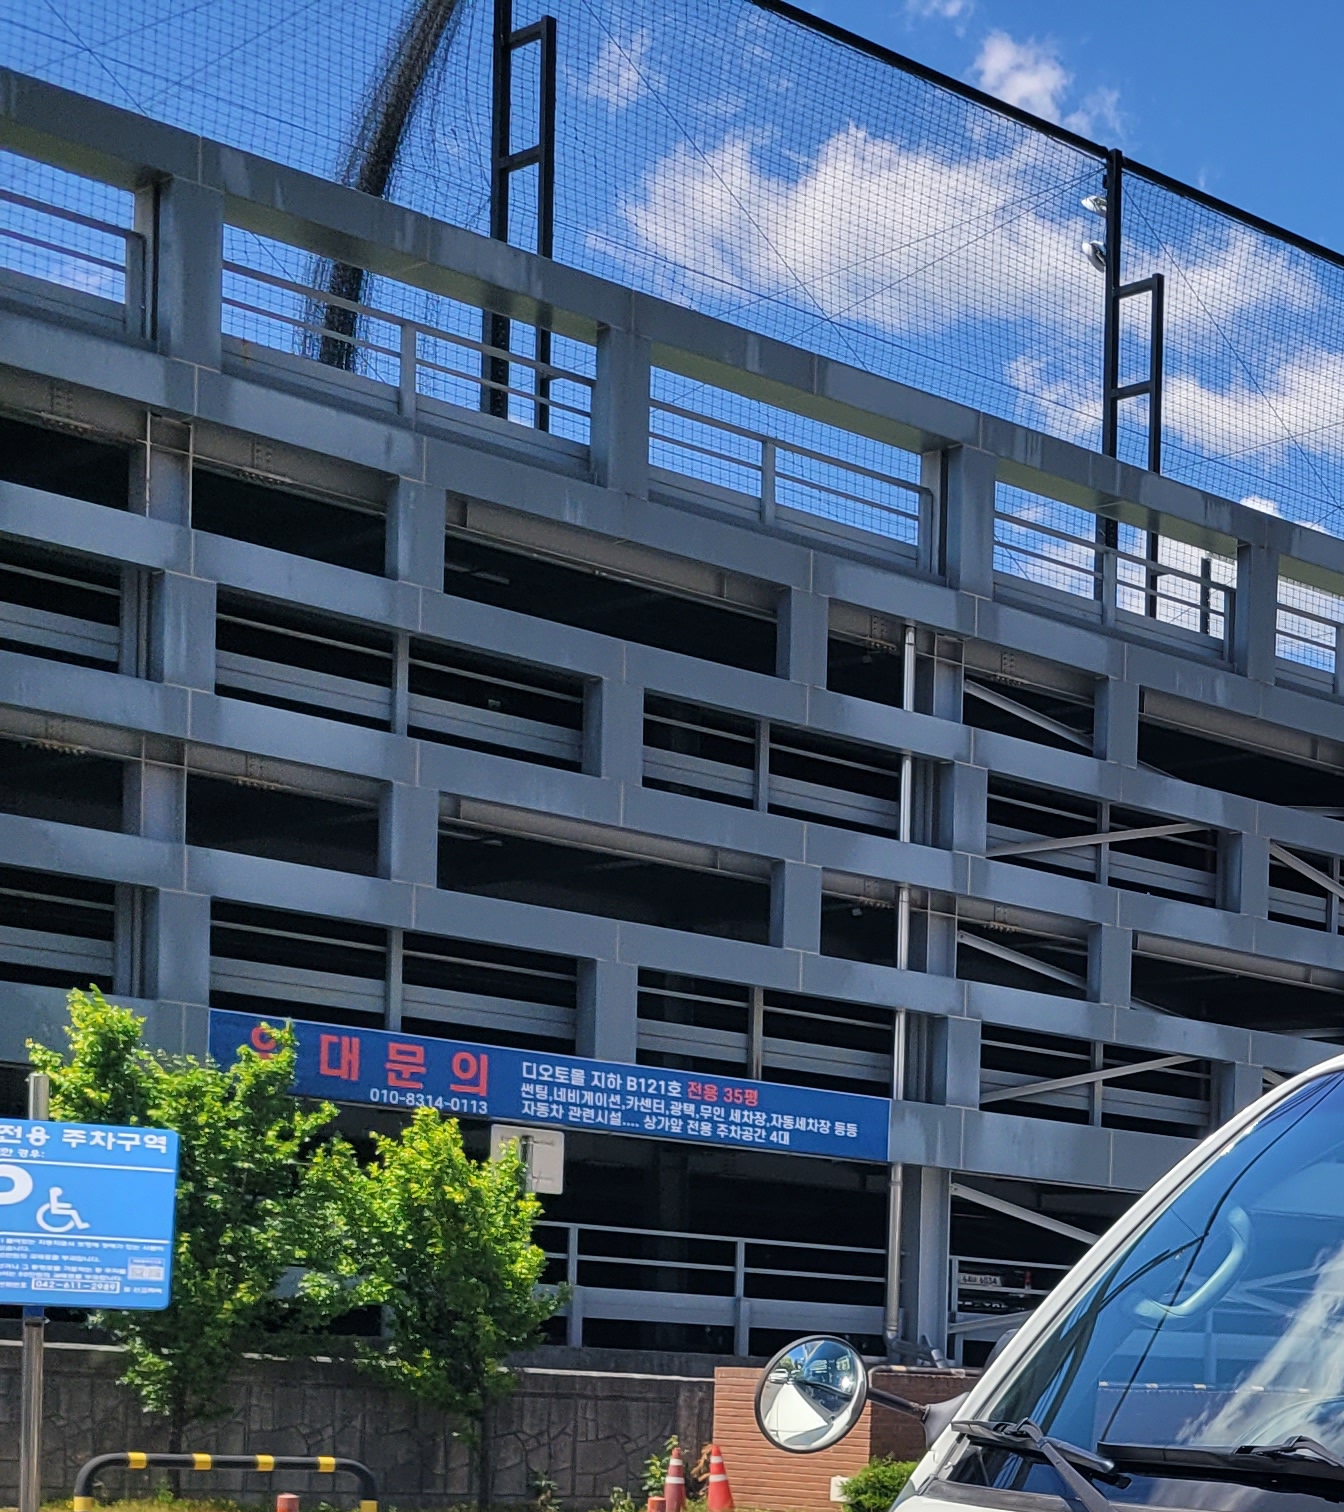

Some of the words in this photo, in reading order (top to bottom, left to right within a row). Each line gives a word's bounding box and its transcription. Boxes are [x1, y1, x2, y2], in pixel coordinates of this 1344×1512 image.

[369, 1088, 489, 1114] 010-8314-0113
[522, 1061, 585, 1087] 디오토몰
[591, 1071, 622, 1091] 지하
[626, 1076, 682, 1098] B121호
[687, 1081, 718, 1102] 전용
[723, 1087, 758, 1107] 35평
[521, 1100, 564, 1119] 자동차
[643, 1115, 683, 1134] 상가앞
[687, 1119, 712, 1137] 전용
[716, 1123, 766, 1144] 주차공간
[769, 1130, 790, 1145] 4대
[62, 1129, 167, 1154] 주차구역
